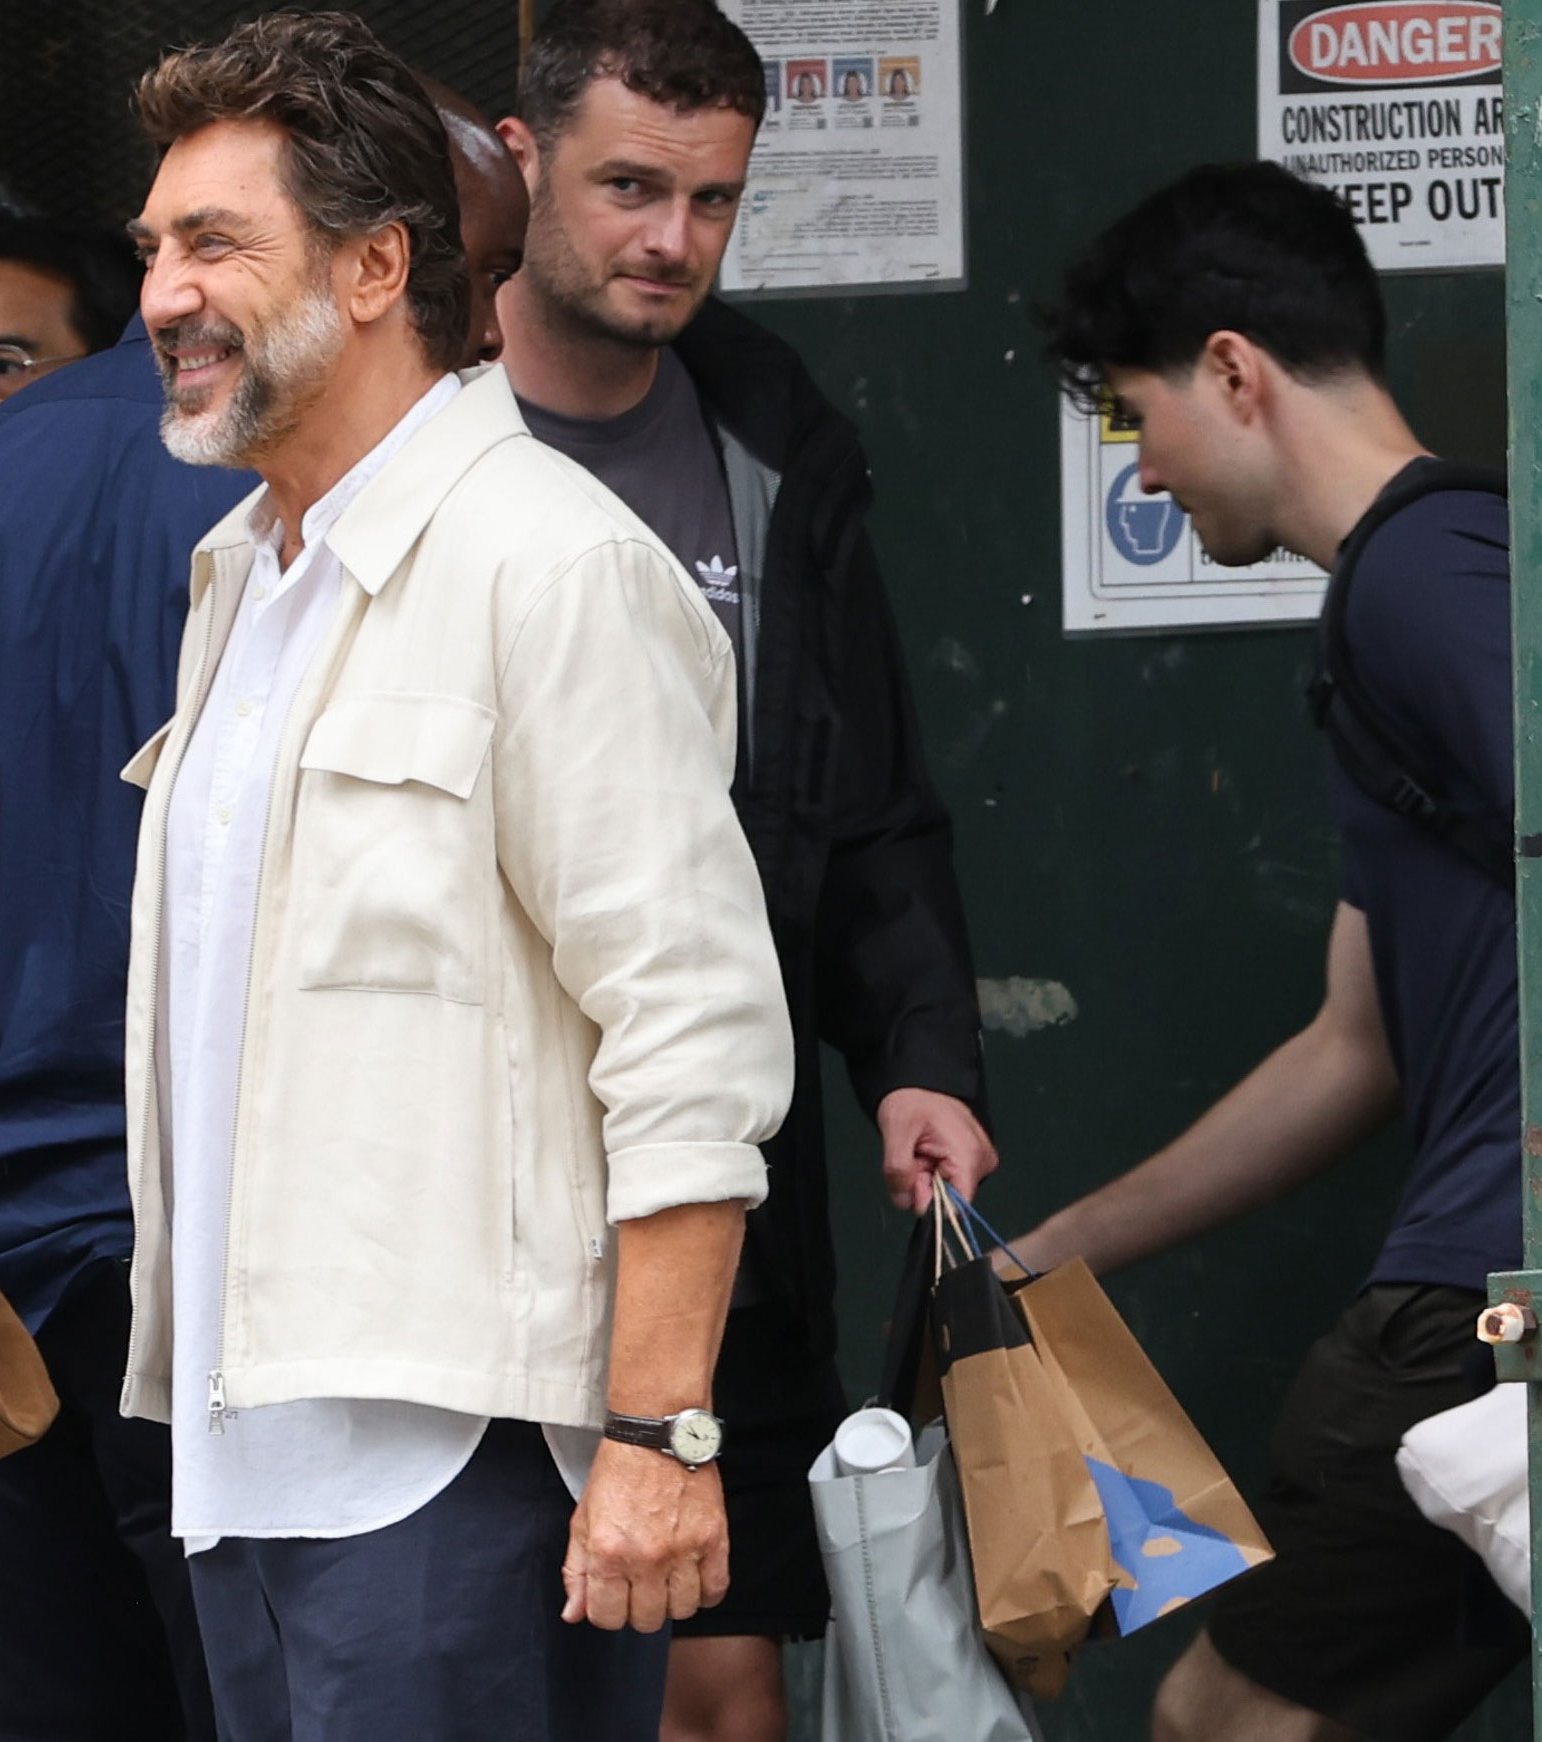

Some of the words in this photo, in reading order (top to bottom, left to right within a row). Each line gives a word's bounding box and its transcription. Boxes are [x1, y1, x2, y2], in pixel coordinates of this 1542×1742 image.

[1310, 15, 1503, 69] DANGER
[1282, 99, 1461, 144] CONSTRUCTION
[1282, 149, 1420, 174] UNAUTHORIZED
[1333, 182, 1412, 225] EEP
[1428, 178, 1501, 221] OUT
